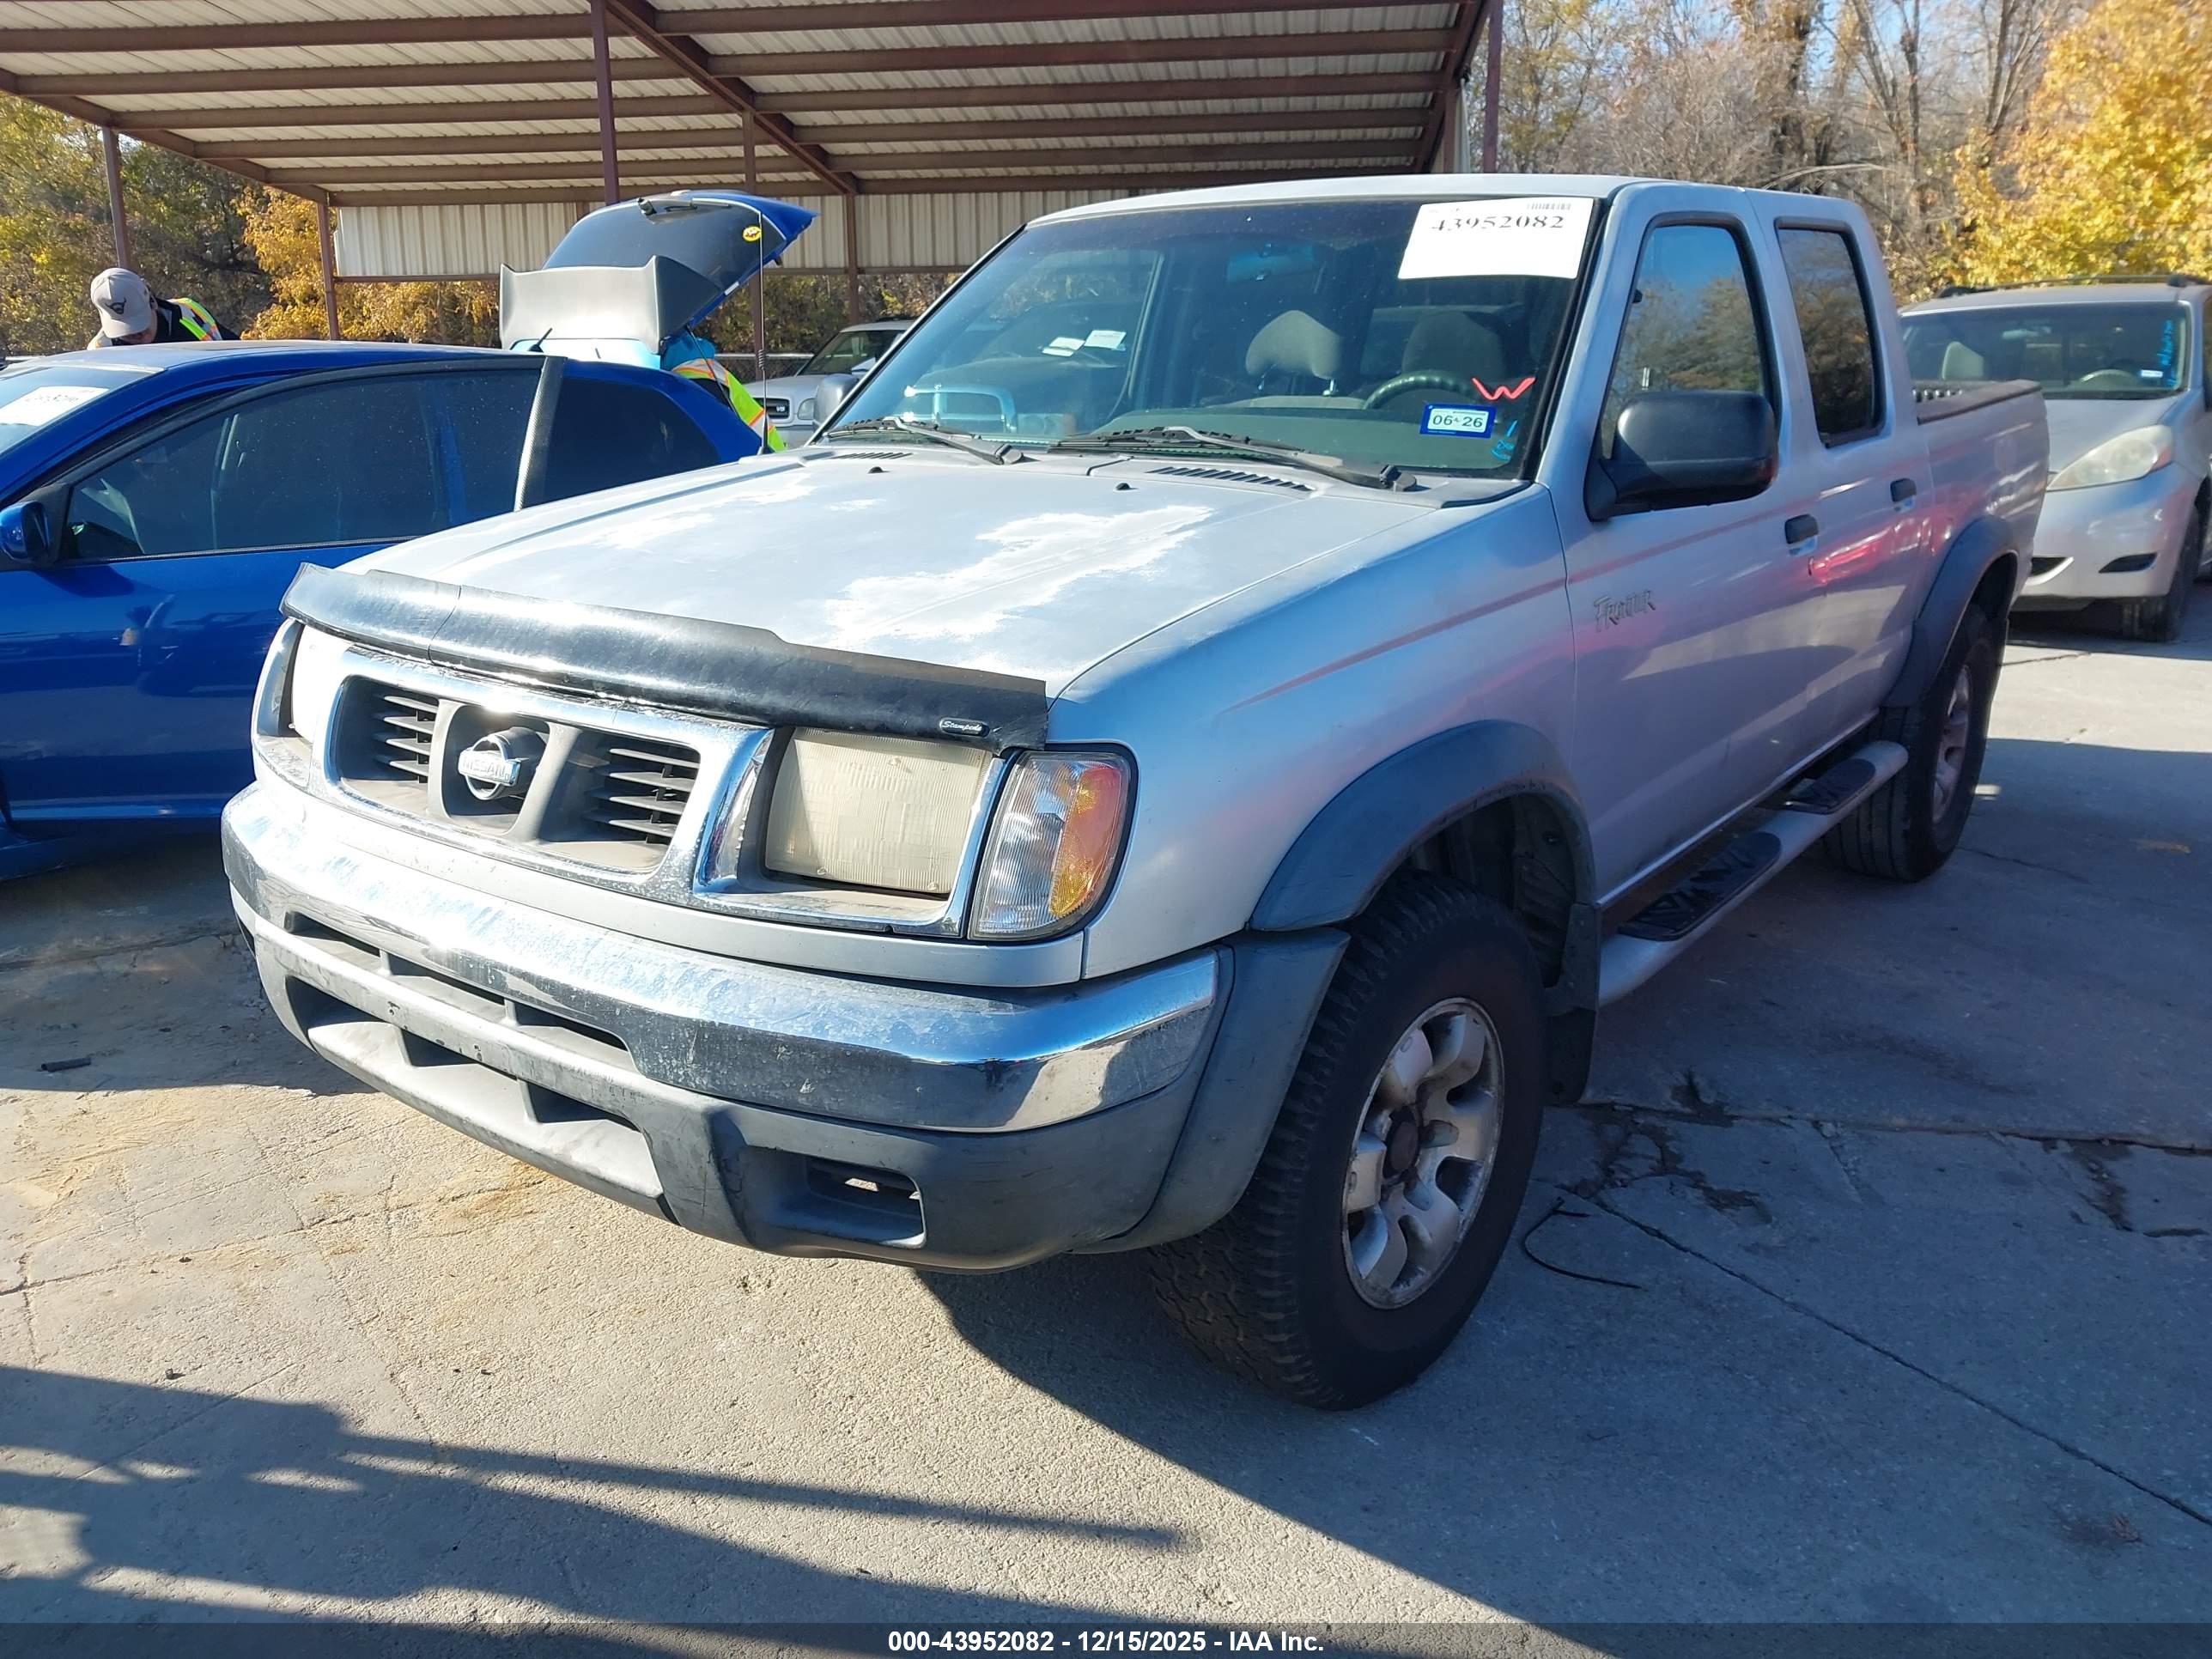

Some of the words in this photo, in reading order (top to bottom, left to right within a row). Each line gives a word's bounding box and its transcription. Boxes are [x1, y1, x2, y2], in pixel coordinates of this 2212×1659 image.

[1431, 216, 1564, 231] 43952082
[1432, 415, 1453, 426] 06
[1462, 416, 1484, 428] 26
[464, 757, 506, 778] NISSAN
